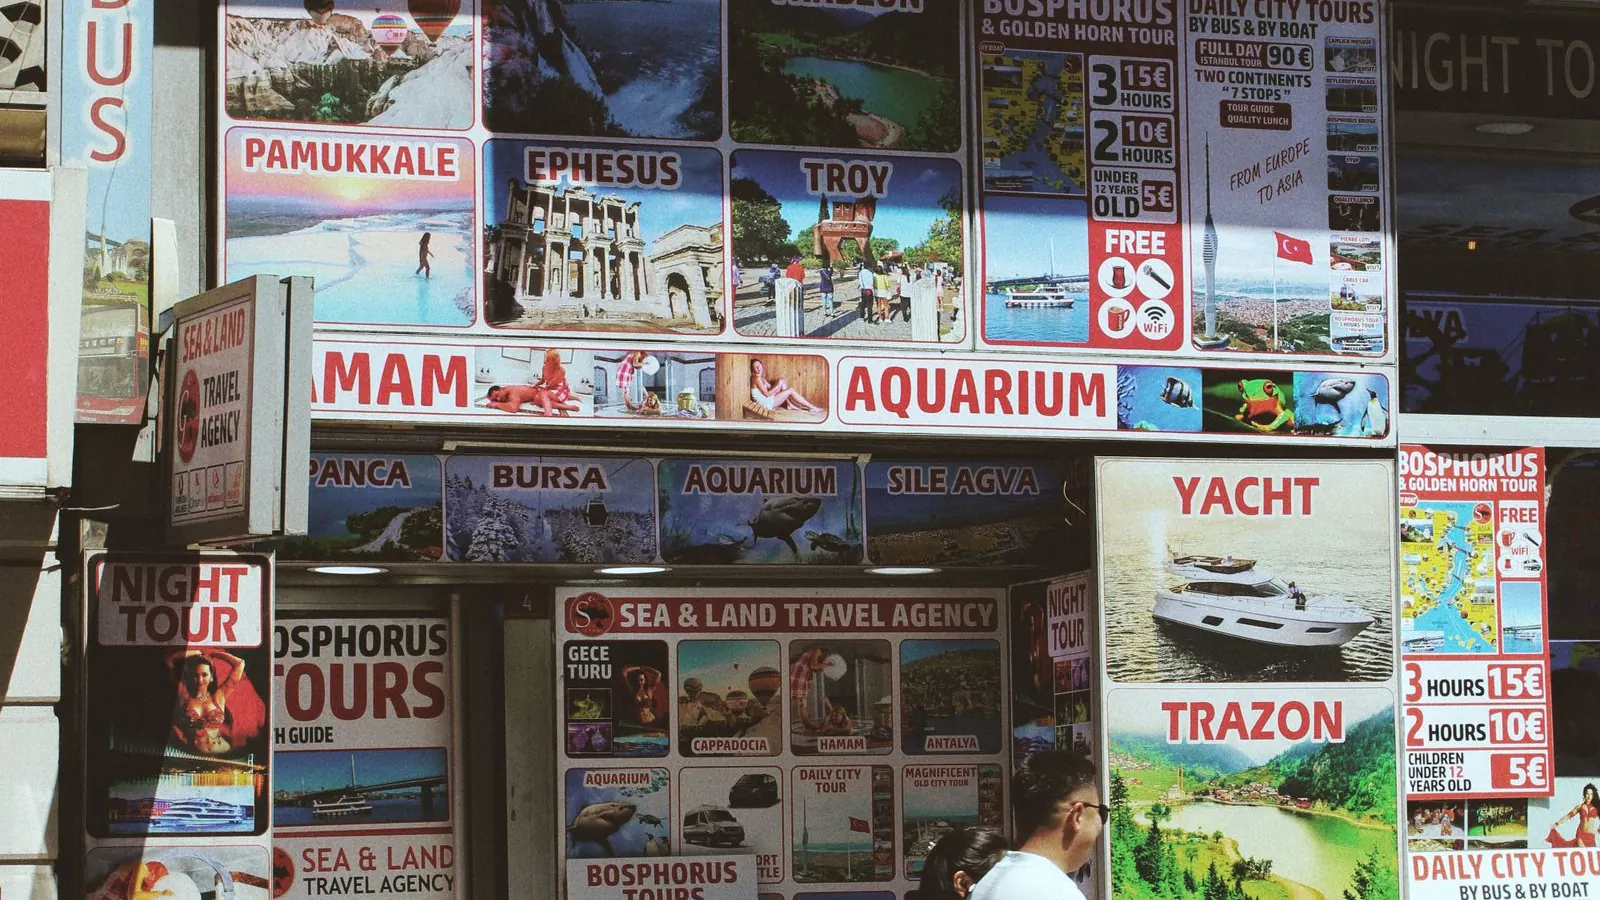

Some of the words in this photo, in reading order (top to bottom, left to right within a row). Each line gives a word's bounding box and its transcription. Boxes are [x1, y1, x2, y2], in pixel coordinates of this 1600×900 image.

[1191, 0, 1247, 19] DAILY
[1254, 0, 1307, 21] CITY
[1308, 0, 1374, 25] TOURS
[982, 18, 994, 35] &
[1000, 19, 1069, 39] GOLDEN
[1075, 24, 1123, 43] HORN
[1128, 27, 1175, 46] TOUR
[1189, 17, 1209, 34] BY
[1212, 18, 1240, 35] BUS
[1242, 20, 1254, 37] &
[1258, 20, 1277, 38] BY
[1280, 22, 1318, 39] BOAT
[1200, 42, 1232, 56] FULL
[1235, 43, 1262, 58] DAY
[1242, 58, 1262, 67] TOUR
[1125, 66, 1167, 90] 15€
[1195, 69, 1223, 84] TWO
[1229, 71, 1311, 88] CONTINENTS
[1536, 38, 1595, 99] TO
[1092, 64, 1117, 105] 3
[1120, 93, 1171, 110] HOURS
[1227, 104, 1247, 112] TOUR
[1250, 104, 1274, 114] GUIDE
[1126, 120, 1168, 144] 10€
[1228, 115, 1262, 125] QUALITY
[1264, 116, 1289, 126] LUNCH
[1093, 120, 1119, 162] 2
[245, 138, 455, 177] PAMUKKALE
[529, 150, 677, 185] EPHESUS
[1121, 148, 1172, 165] HOURS
[1230, 163, 1261, 191] FROM
[1266, 138, 1310, 173] EUROPE
[804, 162, 890, 194] TROY
[1094, 170, 1139, 185] UNDER
[1257, 185, 1273, 204] TO
[1277, 169, 1303, 196] ASIA
[1095, 185, 1106, 195] 12
[1108, 185, 1139, 196] YEARS
[1143, 184, 1173, 207] 5€
[1094, 198, 1140, 218] OLD
[1105, 229, 1165, 256] FREE
[183, 321, 201, 363] SEA
[212, 308, 245, 354] LAND
[203, 369, 241, 408] TRAVEL
[845, 366, 1106, 420] AQUARIUM
[201, 409, 241, 449] AGENCY
[1400, 450, 1538, 477] BOSPHORUS
[493, 464, 607, 490] BURSA
[684, 464, 836, 492] AQUARIUM
[888, 464, 946, 492] SILE
[952, 464, 1039, 492] AGVA
[1409, 477, 1456, 491] GOLDEN
[1459, 478, 1498, 492] HORN
[1501, 478, 1538, 493] TOUR
[1172, 476, 1320, 516] YACHT
[1500, 507, 1538, 523] FREE
[112, 566, 248, 603] NIGHT
[519, 594, 533, 611] 4
[1049, 583, 1086, 619] NIGHT
[119, 606, 238, 643] TOUR
[620, 603, 671, 628] SEA
[678, 603, 699, 627] &
[706, 603, 776, 627] LAND
[783, 603, 885, 627] TRAVEL
[892, 603, 993, 627] AGENCY
[1051, 618, 1084, 651] TOUR
[568, 646, 610, 662] GECE
[567, 664, 612, 680] TURU
[1405, 662, 1422, 703] 3
[1427, 679, 1485, 697] HOURS
[1488, 667, 1543, 697] 15€
[1161, 701, 1343, 741] TRAZON
[1406, 707, 1424, 747] 2
[1428, 724, 1486, 742] HOURS
[1490, 711, 1544, 742] 10€
[290, 726, 334, 744] GUIDE
[819, 738, 864, 750] HAMAM
[927, 737, 977, 749] ANTALYA
[1408, 752, 1464, 765] CHILDREN
[1510, 756, 1545, 786] 5€
[800, 769, 833, 780] DAILY
[835, 768, 861, 780] CITY
[905, 767, 977, 778] MAGNIFICENT
[914, 779, 929, 787] OLD
[930, 779, 947, 787] CITY
[949, 779, 968, 787] TOUR
[1408, 766, 1446, 779] UNDER
[1450, 767, 1464, 778] 12
[815, 782, 846, 793] TOUR
[1409, 779, 1445, 792] YEARS
[1447, 779, 1471, 791] OLD
[302, 846, 351, 873] SEA
[359, 847, 376, 871] &
[388, 845, 454, 870] LAND
[1412, 854, 1483, 881] DAILY
[1491, 852, 1545, 879] CITY
[303, 876, 375, 895] TRAVEL
[380, 874, 454, 894] AGENCY
[587, 861, 737, 886] BOSPHORUS
[1459, 885, 1478, 900] BY
[1482, 884, 1511, 900] BUS
[1515, 883, 1526, 898] &
[1529, 882, 1547, 899] BY
[1551, 881, 1589, 898] BOAT
